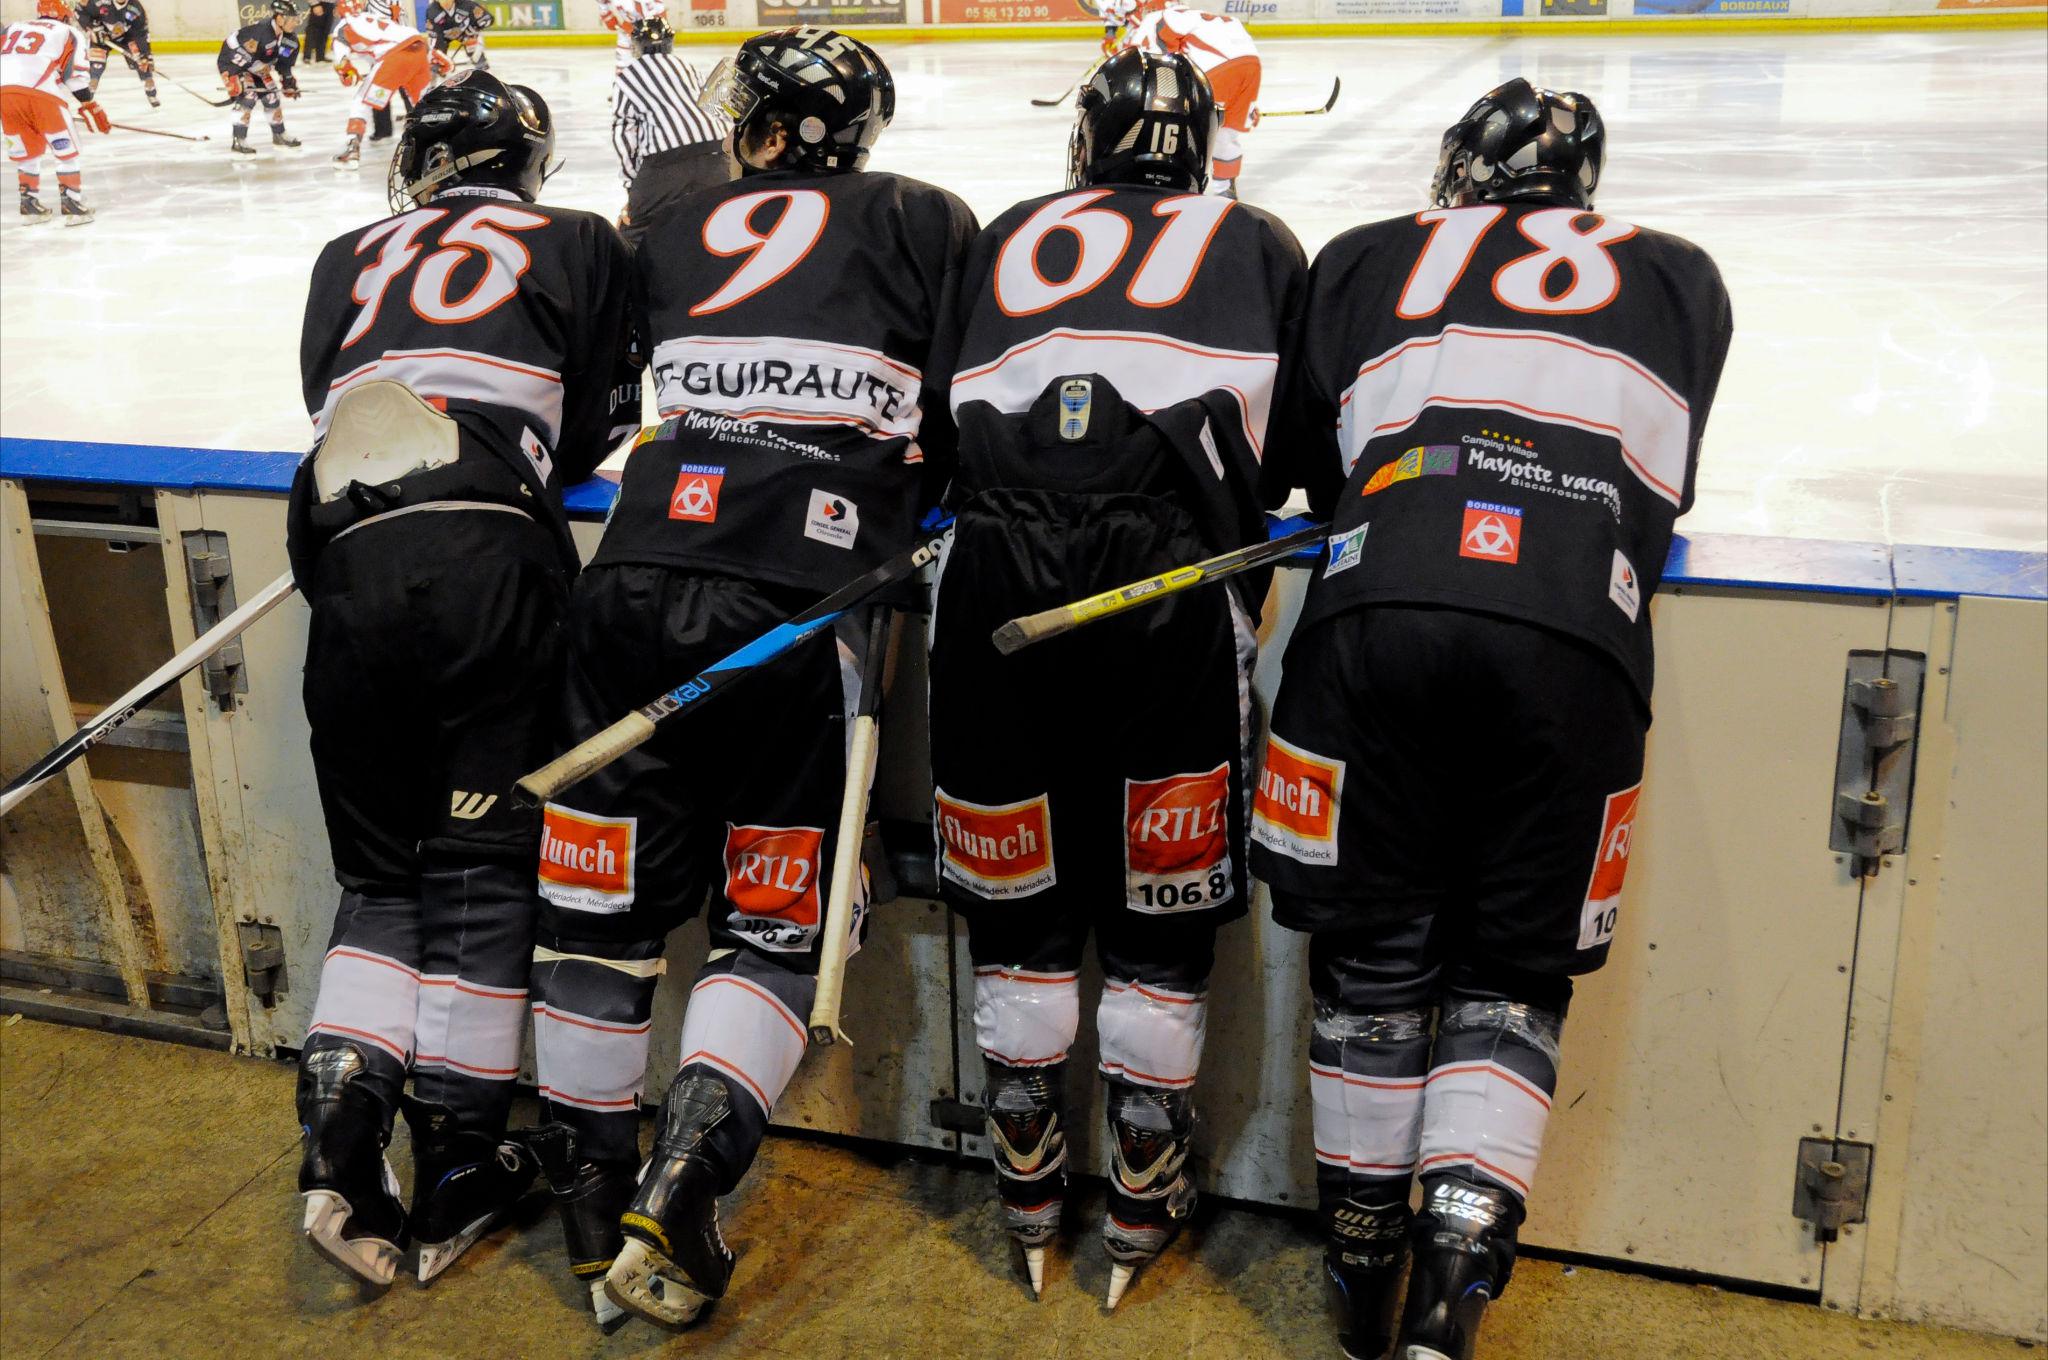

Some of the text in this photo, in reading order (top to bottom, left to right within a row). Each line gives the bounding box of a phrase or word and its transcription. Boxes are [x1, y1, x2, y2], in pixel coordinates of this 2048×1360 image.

[965, 7, 980, 18] 05
[1000, 7, 1014, 18] 13
[1016, 6, 1031, 18] 20
[1033, 5, 1049, 18] 90
[1224, 0, 1277, 16] Ellipse
[1719, 1, 1789, 12] BORDEAUX
[1149, 121, 1180, 155] 16
[688, 189, 831, 316] 9
[993, 189, 1239, 317] 61
[1395, 205, 1641, 320] 18
[340, 204, 551, 350] 75
[684, 410, 759, 440] Mayotte
[718, 432, 787, 451] Biscarrosse
[1461, 434, 1539, 459] Camping Village
[681, 463, 726, 475] BORDEAUX
[1467, 447, 1553, 482] Mayotte
[1510, 477, 1587, 501] Biscarrosse
[1466, 500, 1522, 517] BORDEAUX
[540, 823, 616, 875] lunch
[943, 814, 1038, 861] flunch
[737, 852, 810, 893] RTL2
[1137, 872, 1227, 908] 106.8
